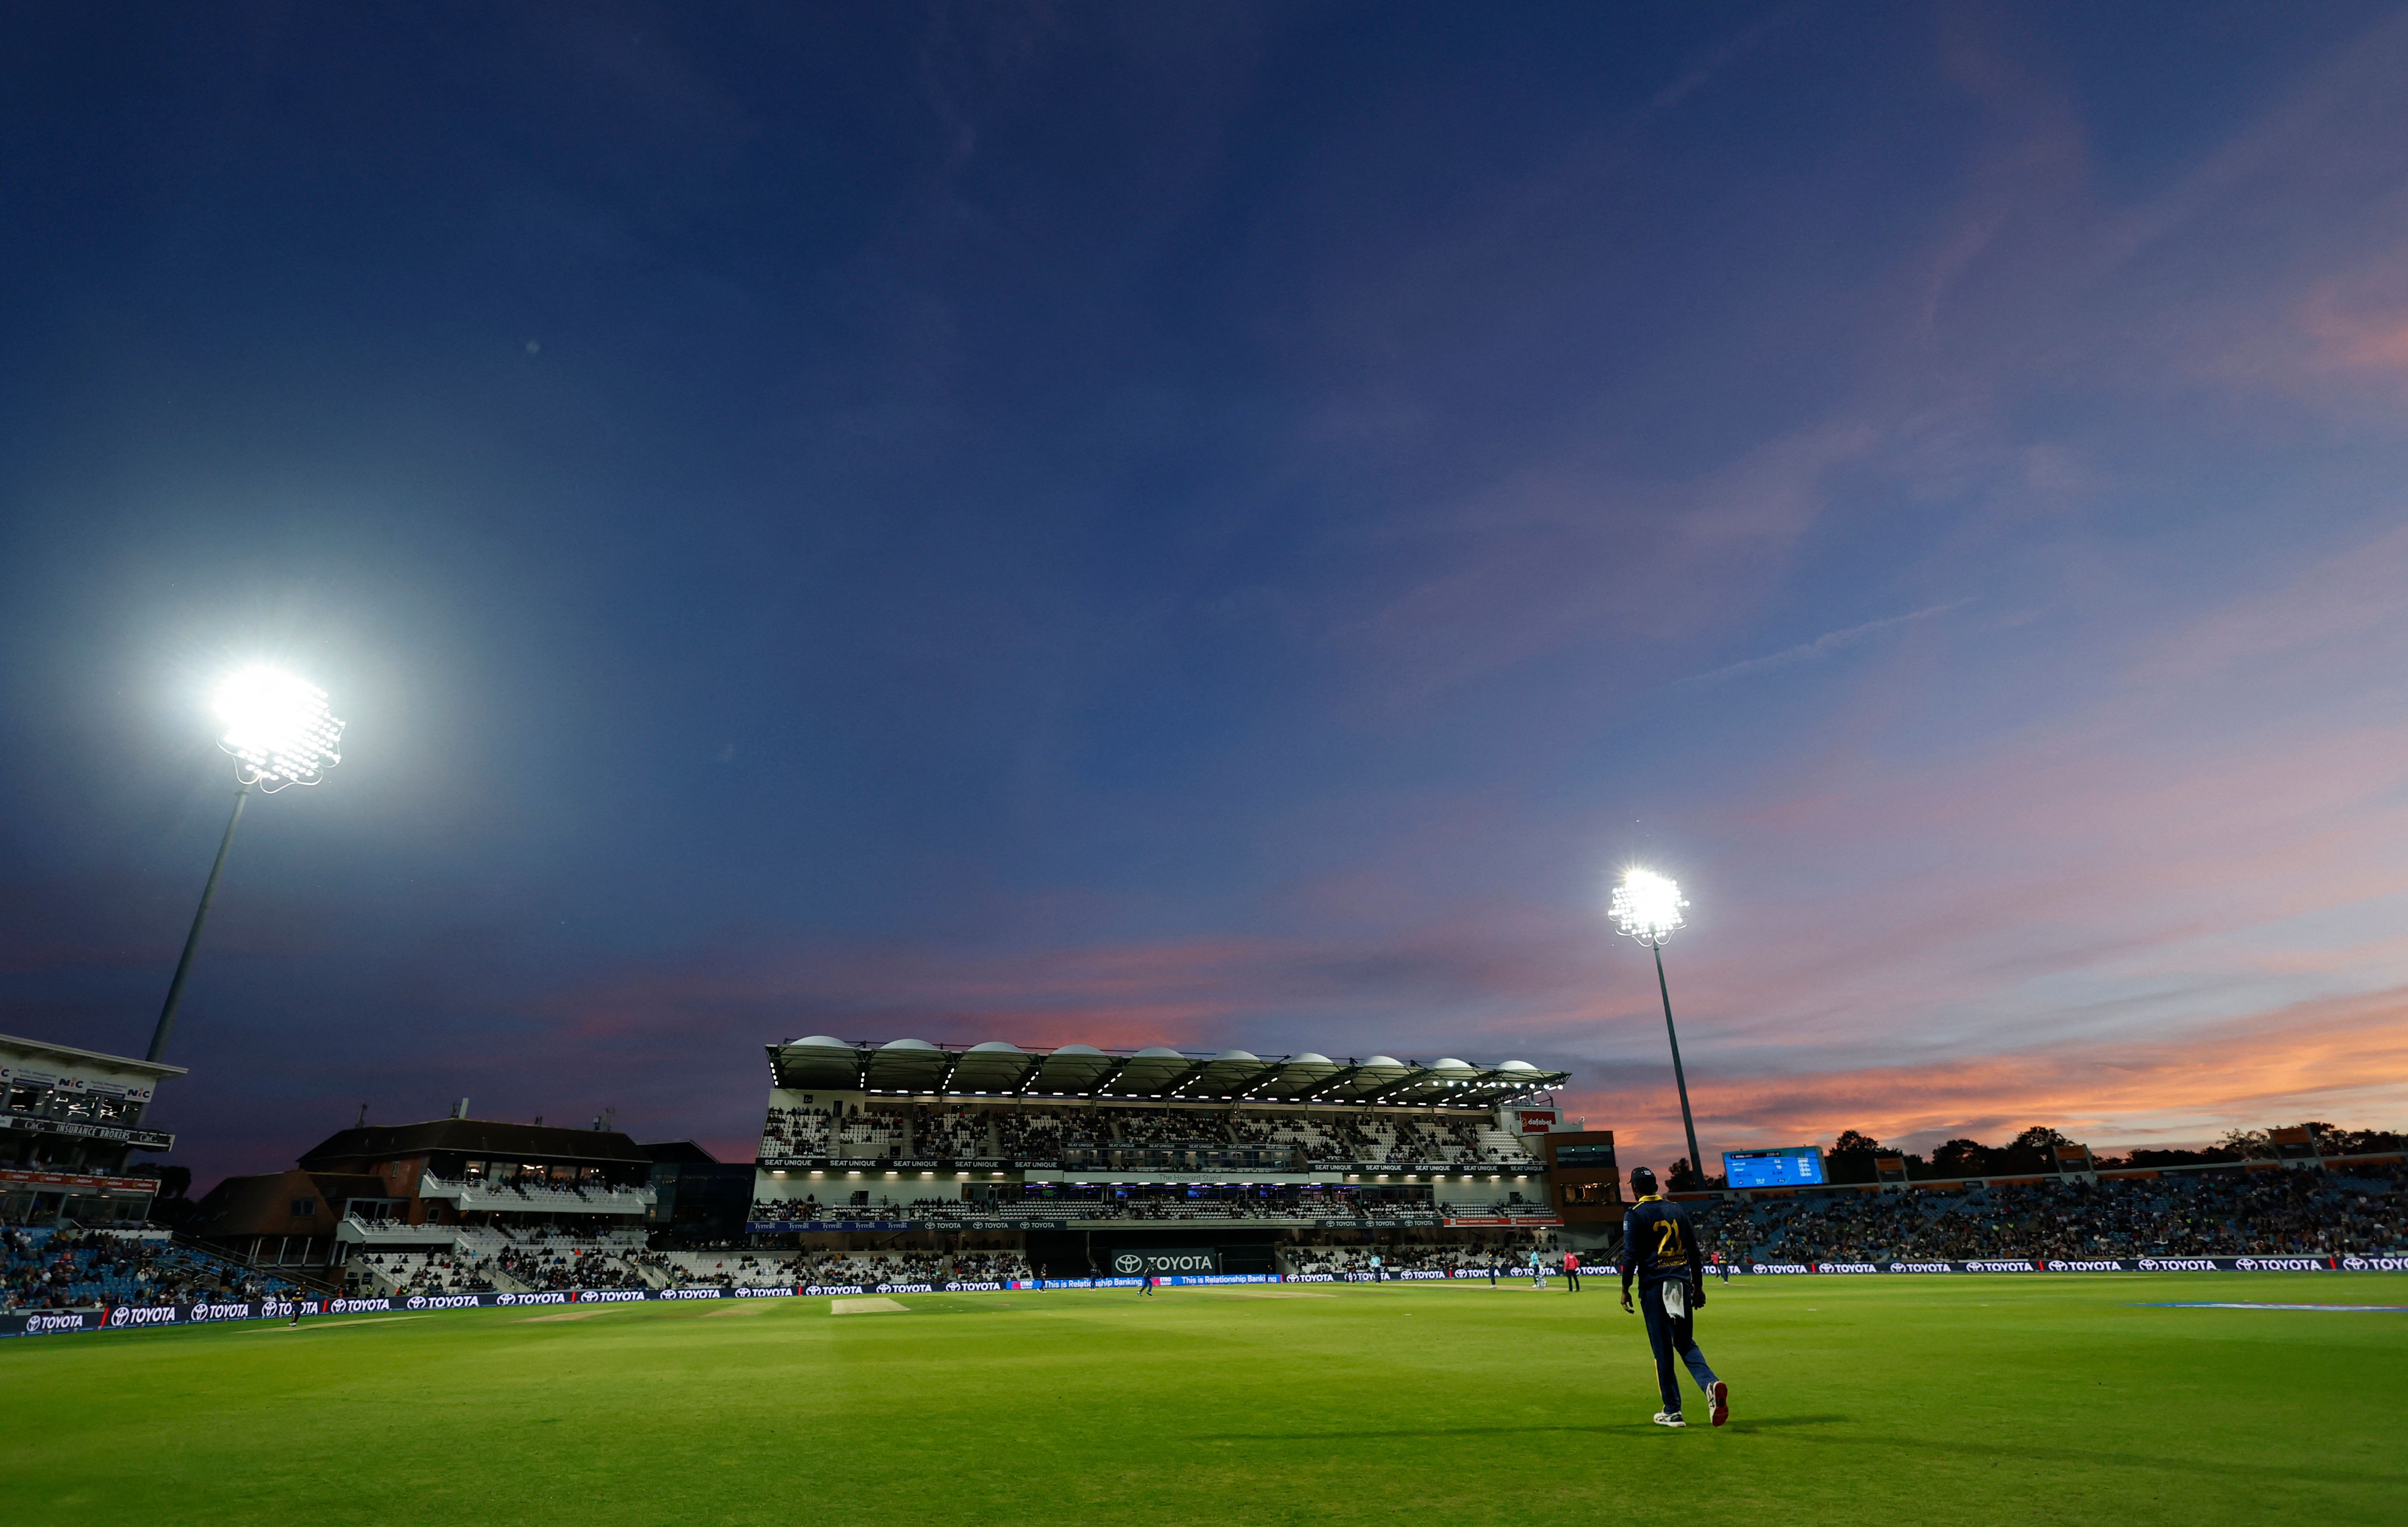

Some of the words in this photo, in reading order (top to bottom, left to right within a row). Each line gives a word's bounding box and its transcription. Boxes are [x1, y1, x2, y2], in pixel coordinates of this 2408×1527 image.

[1528, 1118, 1553, 1126] dafabet
[56, 1124, 97, 1136] INSURANCE
[100, 1129, 130, 1140] BROKERS
[1653, 1219, 1685, 1257] 21
[1147, 1256, 1212, 1271] TOYOTA
[1834, 1264, 1877, 1273] TOYOTA
[1905, 1264, 1951, 1272] TOYOTA
[1982, 1262, 2033, 1271] TOYOTA
[2067, 1261, 2121, 1271] TOYOTA
[2157, 1260, 2217, 1270] TOYOTA
[2257, 1260, 2322, 1271] TOYOTA
[2368, 1258, 2408, 1270] TOY
[1467, 1269, 1500, 1277] TOYOA
[1522, 1268, 1556, 1276] TOOTA
[1581, 1266, 1618, 1275] TOYOTA
[1767, 1264, 1808, 1274] TOYOTA
[1205, 1275, 1246, 1283] Relationship
[1300, 1273, 1334, 1282] TOYOTA
[1357, 1272, 1390, 1281] TOYTA
[1413, 1271, 1445, 1279] TOYOTA
[961, 1282, 1001, 1291] TOYOTA
[1061, 1280, 1067, 1288] is
[1114, 1277, 1142, 1287] Banking
[752, 1288, 793, 1297] TOYOTA
[822, 1286, 863, 1295] TOYOTA
[892, 1284, 932, 1293] TOYOTA
[518, 1293, 565, 1304] TOYOTA
[600, 1291, 645, 1302] TOYOTA
[678, 1289, 720, 1299] TOYOTA
[348, 1299, 389, 1312] TOYOTA
[428, 1296, 479, 1308] TOYOTA
[209, 1304, 249, 1319] TOYOTA
[279, 1302, 318, 1315] TOOTA
[130, 1307, 175, 1323] TOYOTA
[42, 1315, 82, 1329] TOYOTA
